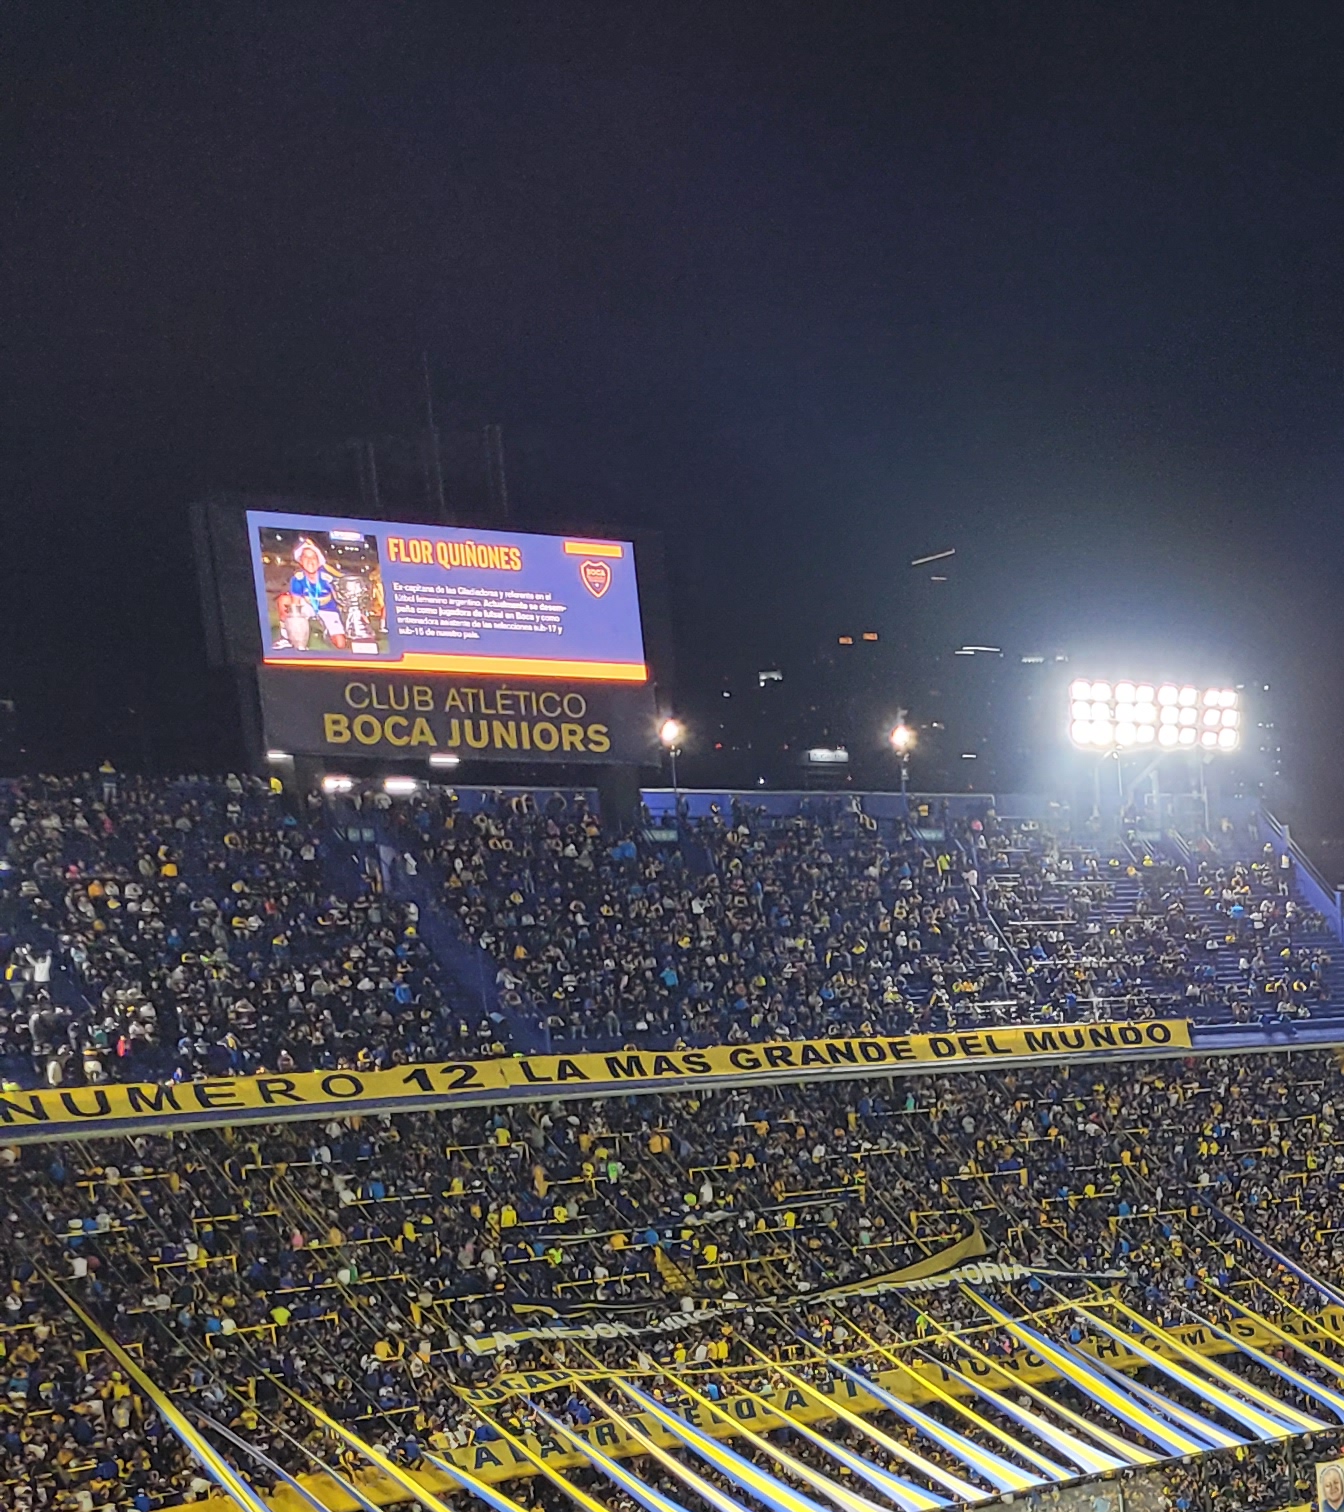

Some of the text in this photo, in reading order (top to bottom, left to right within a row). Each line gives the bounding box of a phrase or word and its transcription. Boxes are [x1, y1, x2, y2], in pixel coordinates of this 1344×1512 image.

[388, 538, 522, 571] FLOR QUIÑONES
[344, 682, 587, 719] CLUB ATLÉTICO
[324, 713, 611, 753] BOCA JUNIORS
[2, 1022, 1173, 1122] NUMERO 12 LA MAS GRANDE DEL MUNDO
[905, 1263, 1031, 1292] HISTORIA
